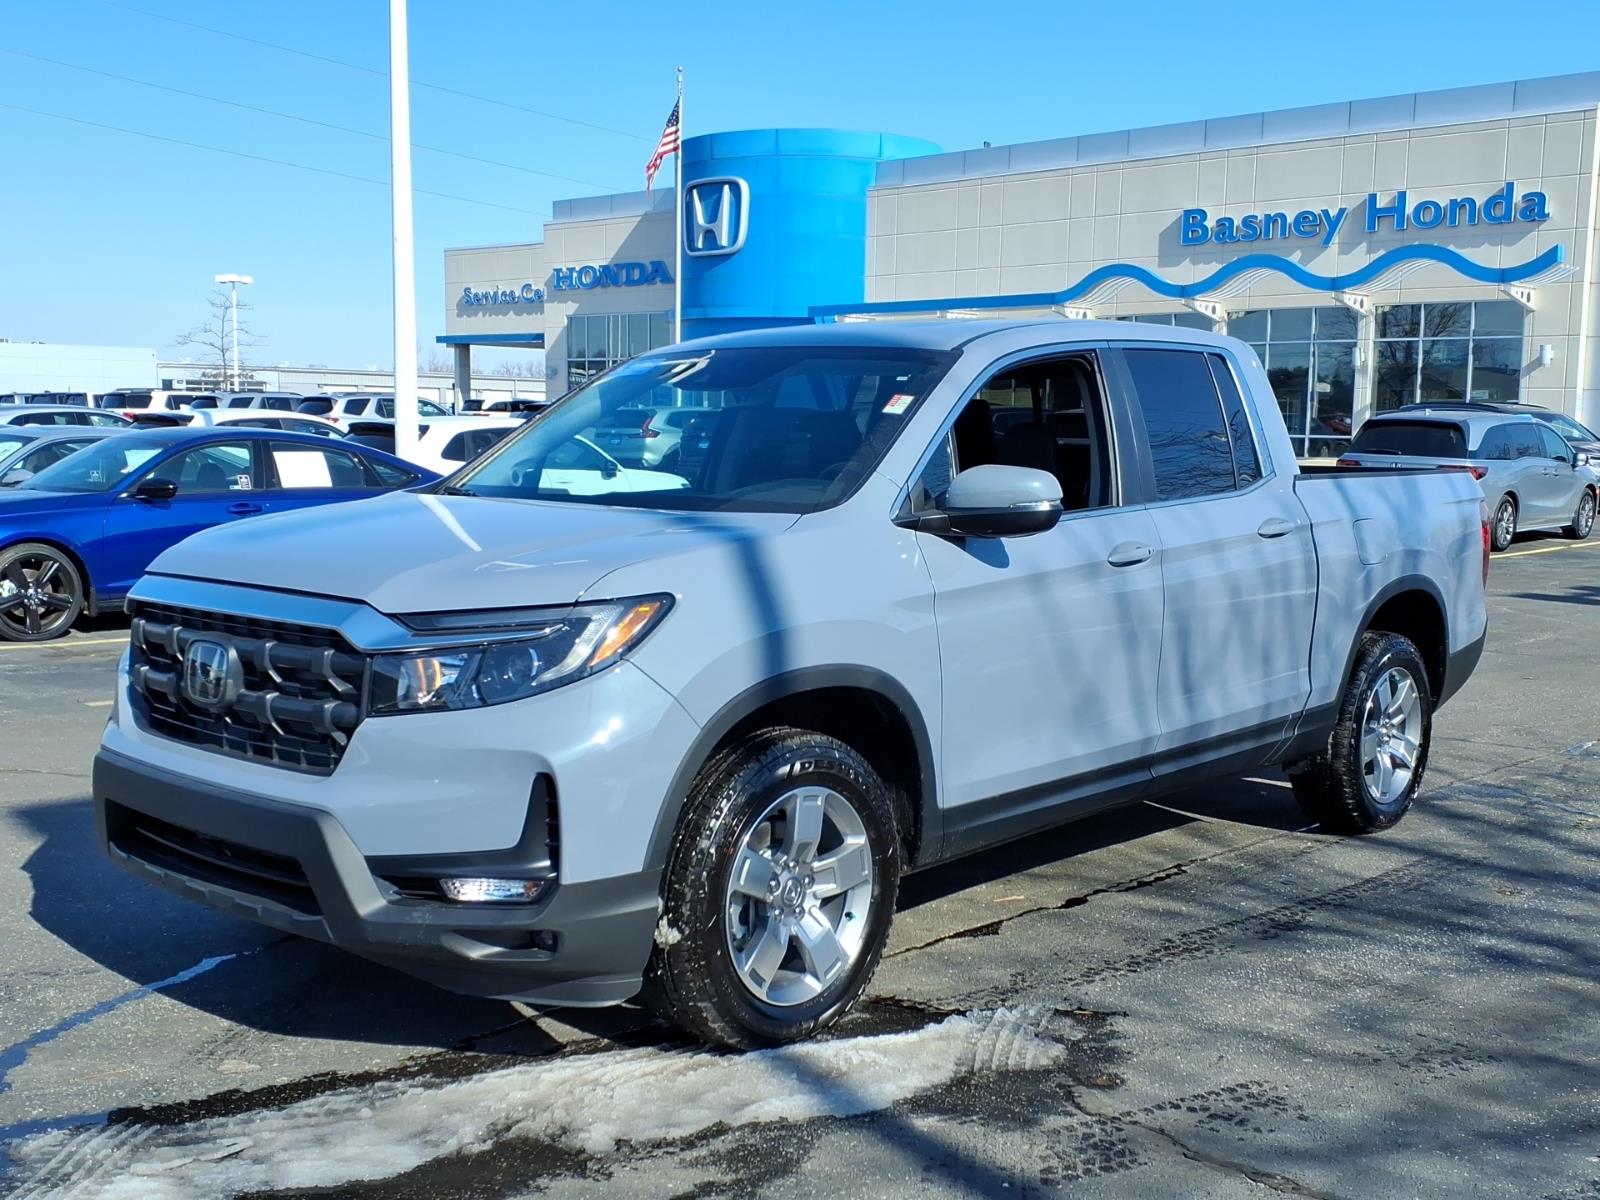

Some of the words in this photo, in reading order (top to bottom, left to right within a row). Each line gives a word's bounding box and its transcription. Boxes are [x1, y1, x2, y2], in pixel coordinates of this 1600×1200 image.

[1181, 207, 1348, 248] Basney
[1366, 181, 1551, 232] Honda
[553, 260, 675, 290] HONDA
[463, 286, 519, 306] Service
[521, 283, 544, 303] Ce
